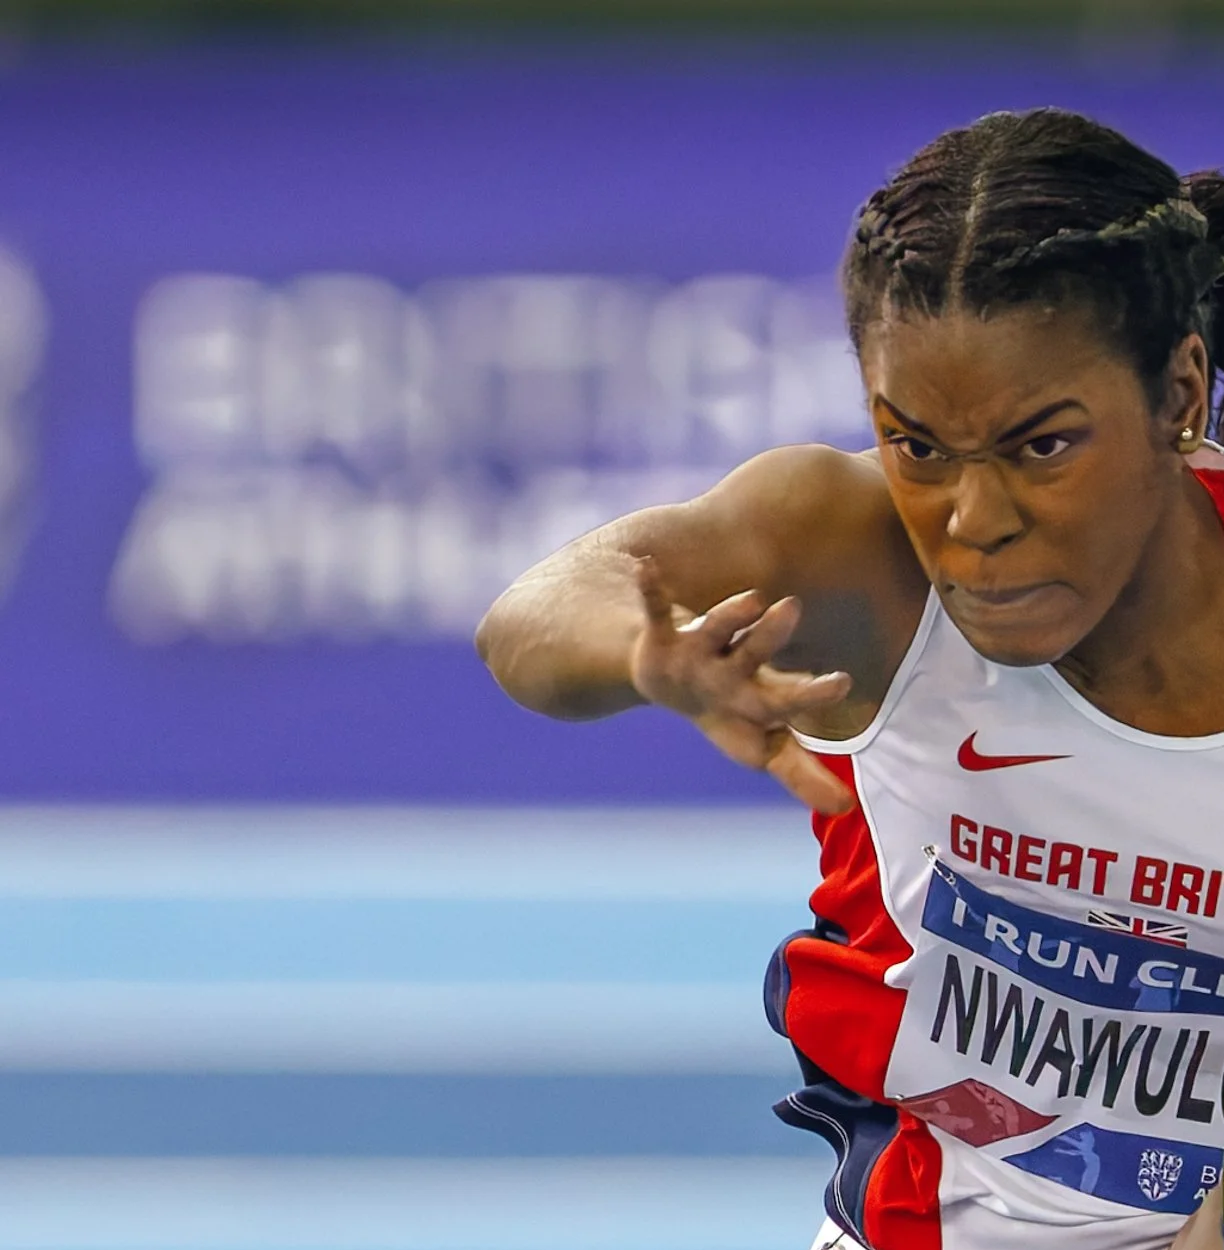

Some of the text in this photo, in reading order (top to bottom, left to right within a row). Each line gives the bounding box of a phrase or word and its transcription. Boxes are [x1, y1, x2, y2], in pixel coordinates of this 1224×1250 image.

[950, 813, 1118, 896] GREAT
[951, 896, 968, 928] I
[984, 916, 1120, 985] RUN
